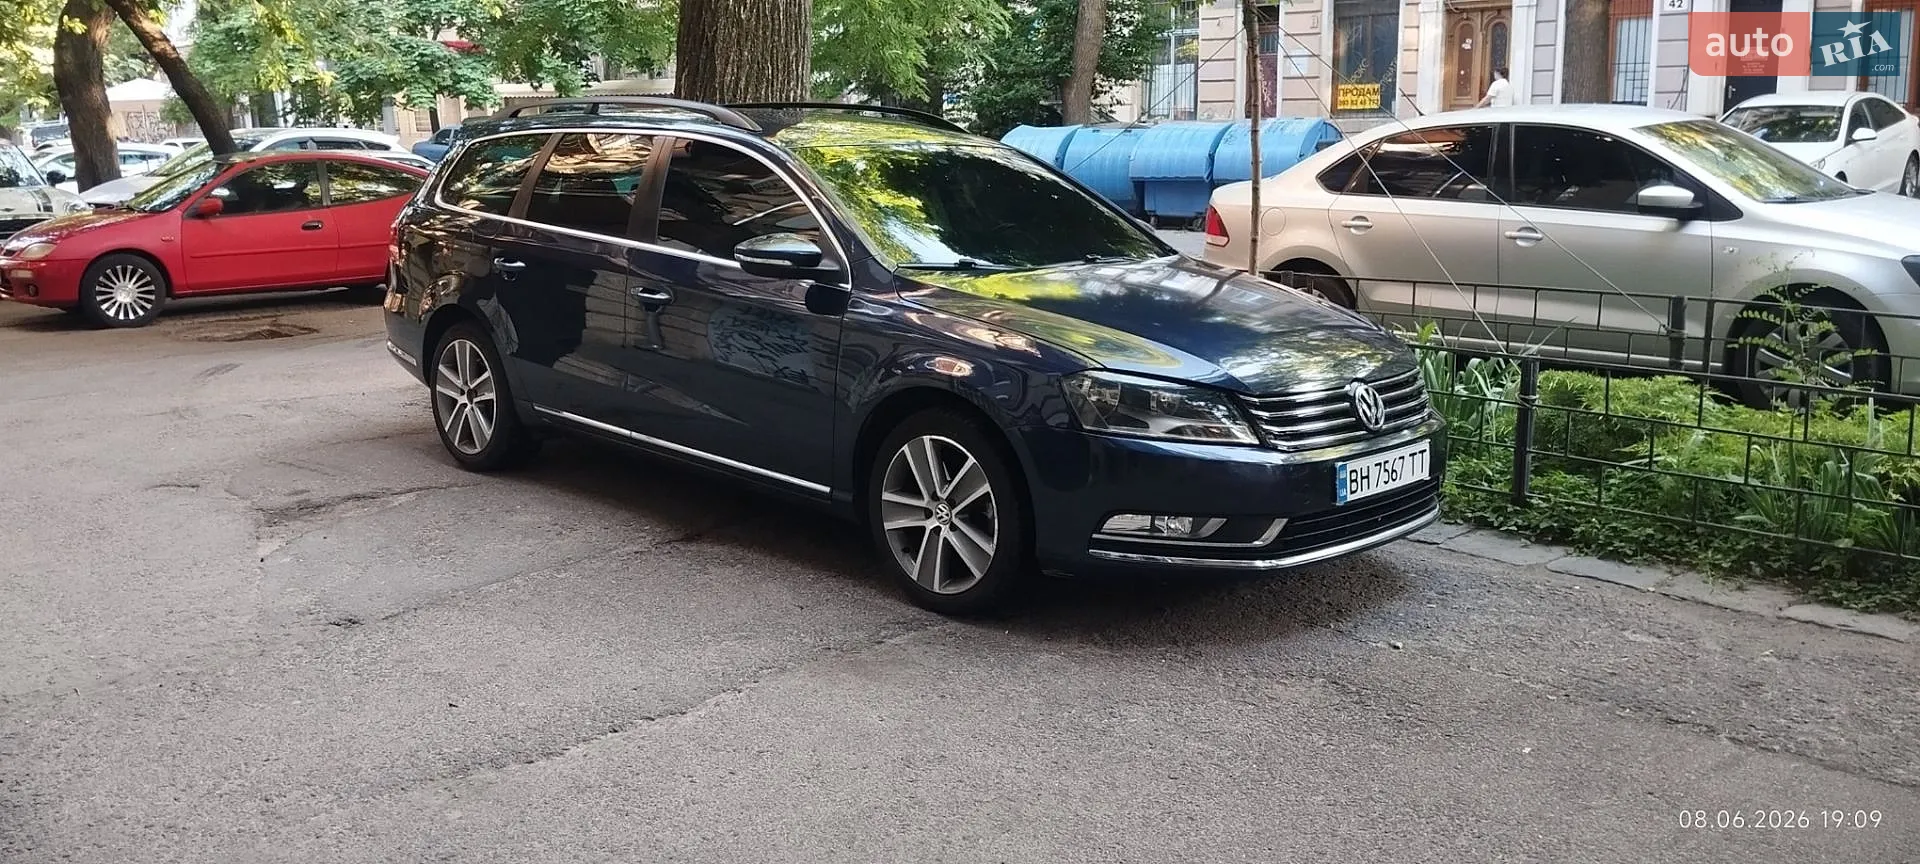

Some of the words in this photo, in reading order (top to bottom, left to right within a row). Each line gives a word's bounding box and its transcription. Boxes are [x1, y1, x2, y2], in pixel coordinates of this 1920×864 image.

[1669, 0, 1683, 9] 42
[1338, 87, 1380, 97] ПРОДАМ
[1349, 465, 1370, 495] BH
[1374, 456, 1405, 488] 7567
[1409, 449, 1427, 477] TT
